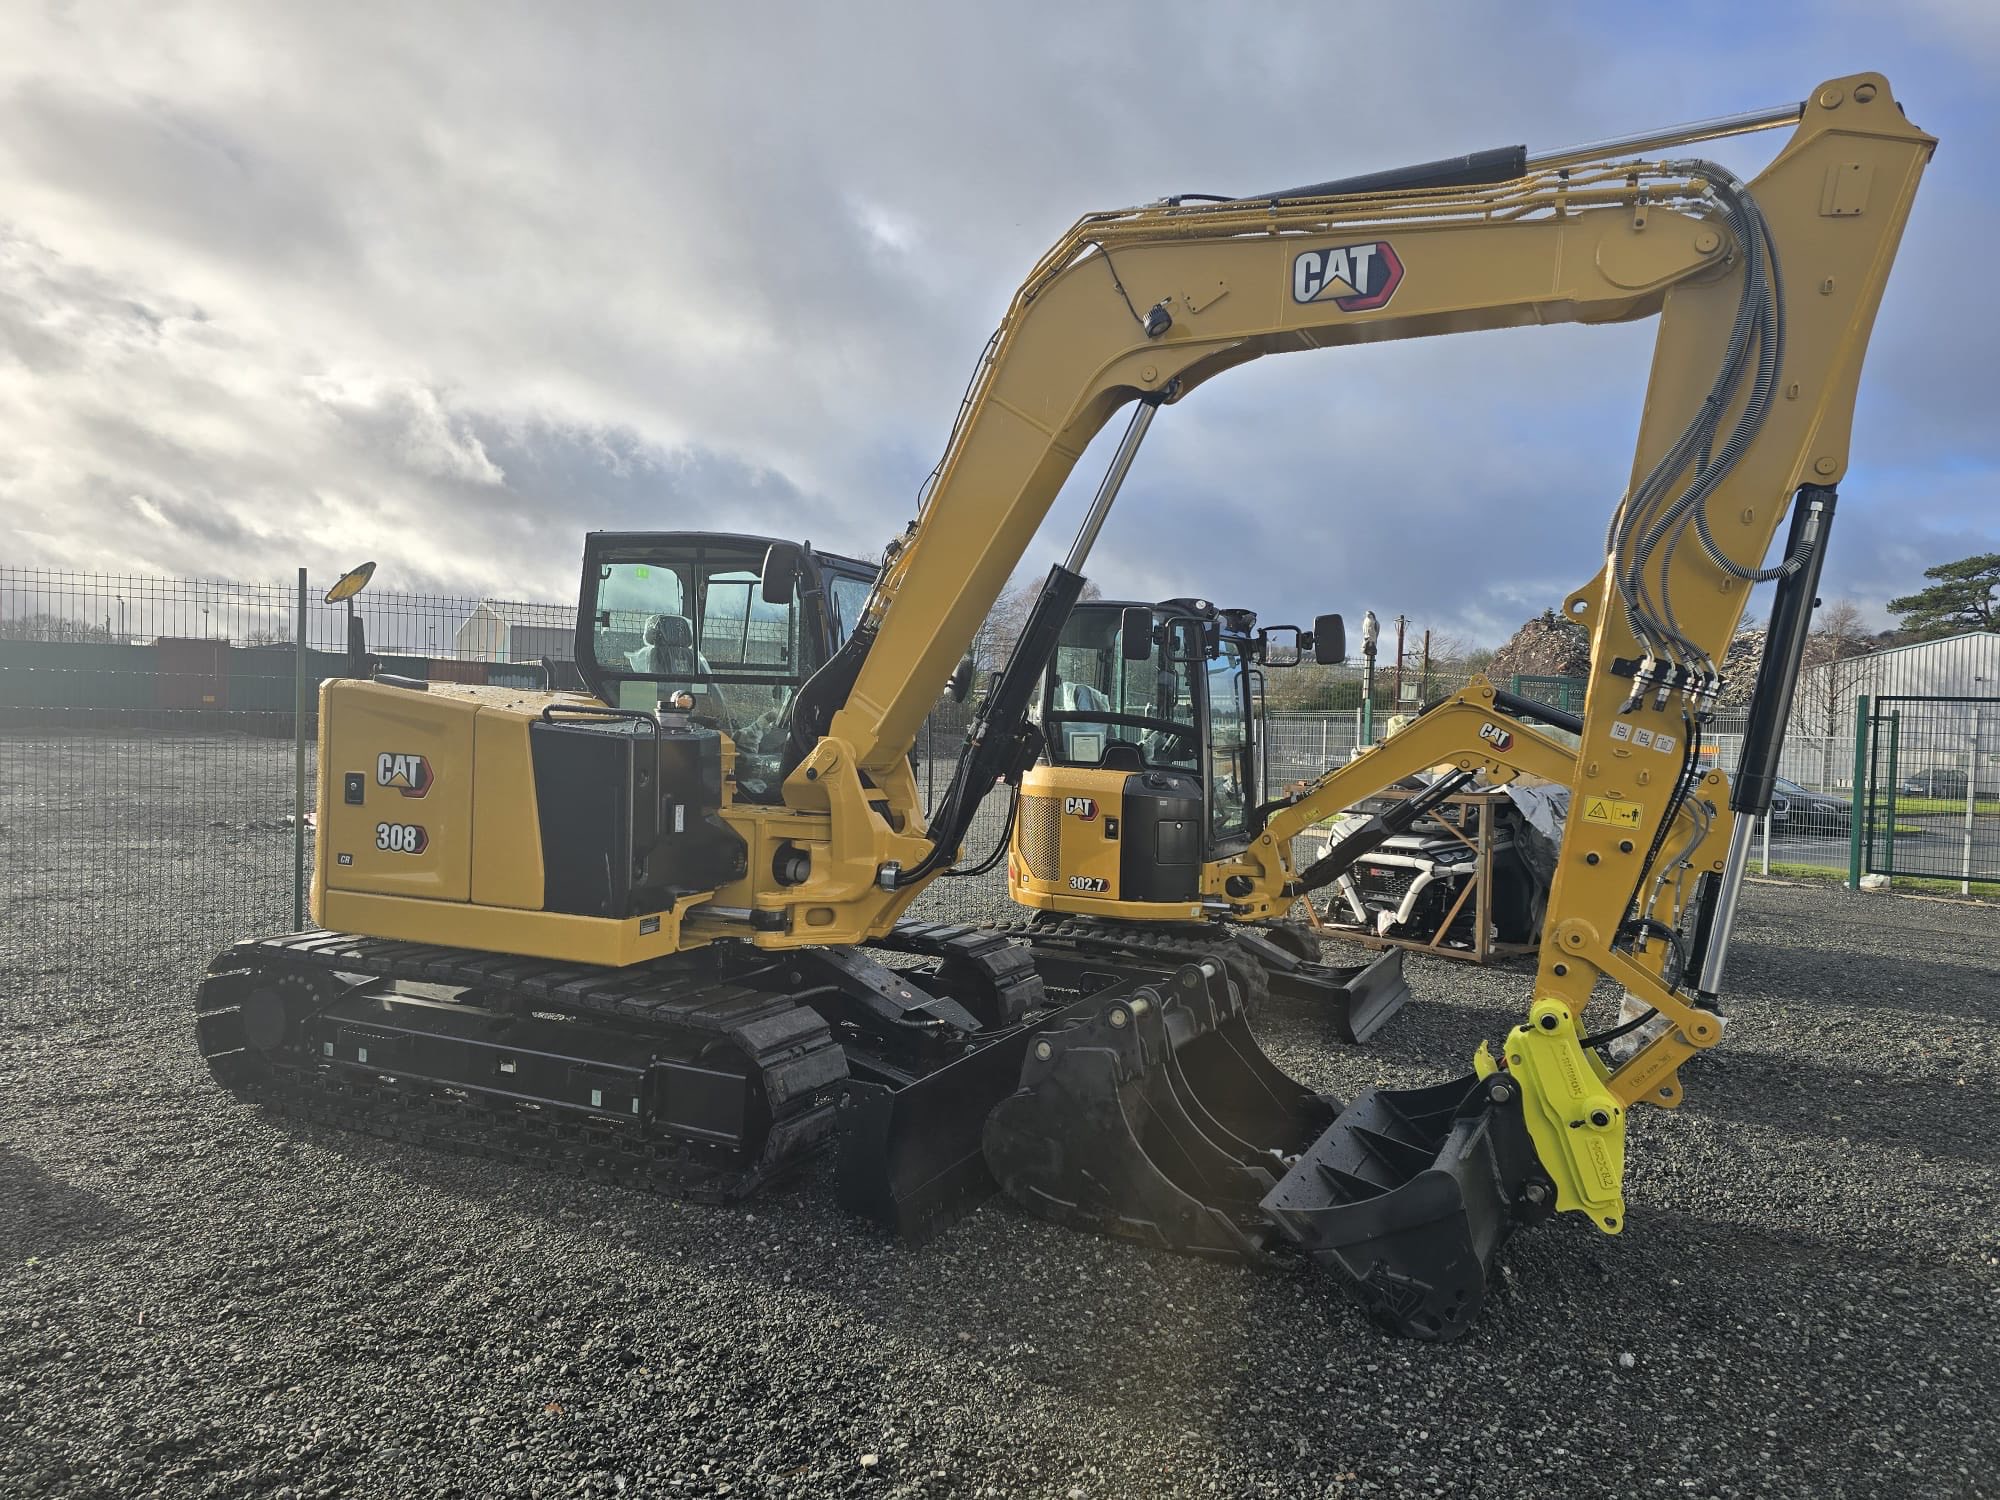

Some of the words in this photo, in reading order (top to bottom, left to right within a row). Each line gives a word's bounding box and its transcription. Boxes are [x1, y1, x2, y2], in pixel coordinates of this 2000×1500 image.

[1295, 244, 1376, 302] CAT
[1480, 722, 1509, 746] CAT
[378, 753, 420, 788] CAT
[1065, 797, 1091, 816] CAT
[377, 823, 416, 852] 308
[1069, 876, 1104, 892] 302.7
